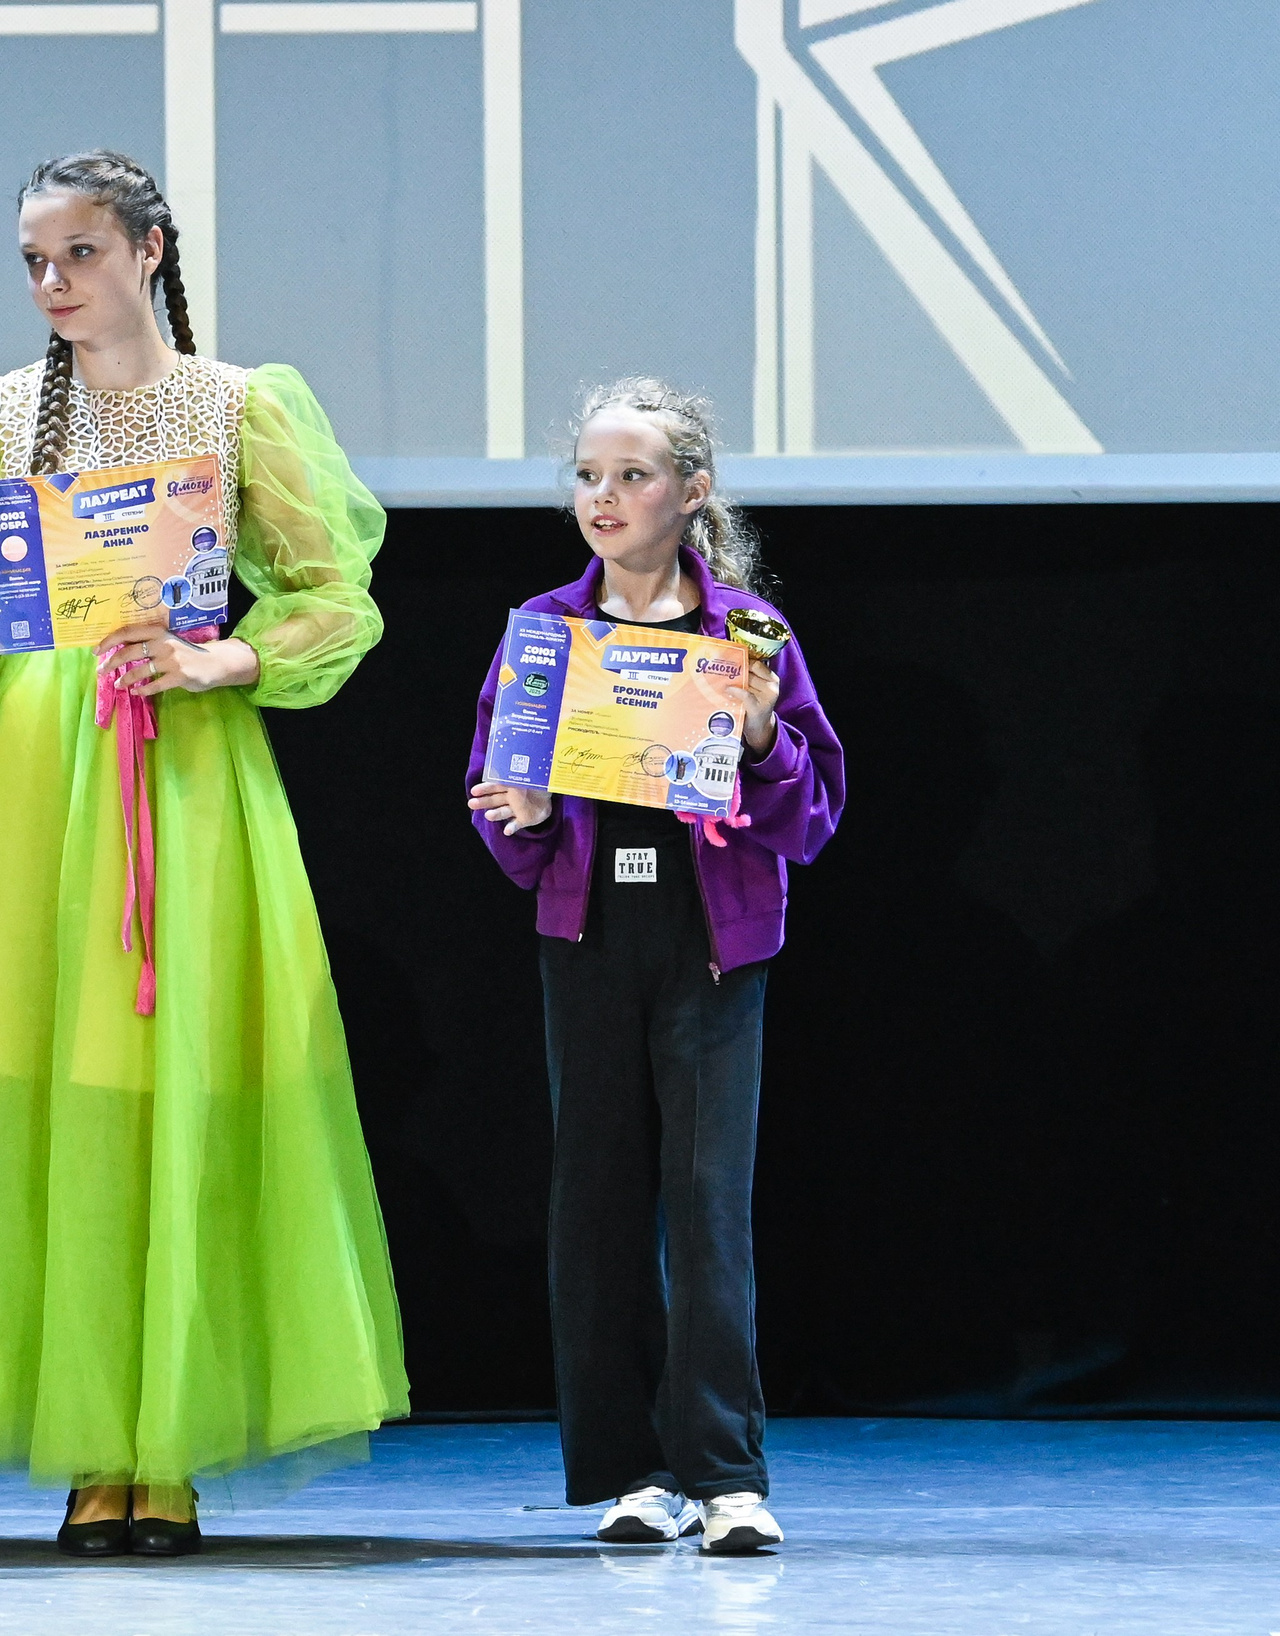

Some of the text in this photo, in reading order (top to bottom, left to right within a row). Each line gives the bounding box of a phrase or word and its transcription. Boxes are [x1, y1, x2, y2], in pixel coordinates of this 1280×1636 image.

[80, 485, 148, 509] ЛАУРЕАТ
[84, 524, 149, 540] ЛАЗАРЕНКО
[103, 538, 134, 548] АННА
[524, 645, 556, 657] СОЮЗ
[520, 654, 556, 666] ДОБРА
[609, 650, 679, 665] ЛАУРЕАТ
[647, 674, 669, 682] СТЕПЕНИ
[612, 685, 664, 699] ЕРОХИНА
[616, 697, 658, 709] ЕСЕНИЯ
[626, 852, 648, 861] STAY
[619, 862, 653, 874] TRUE
